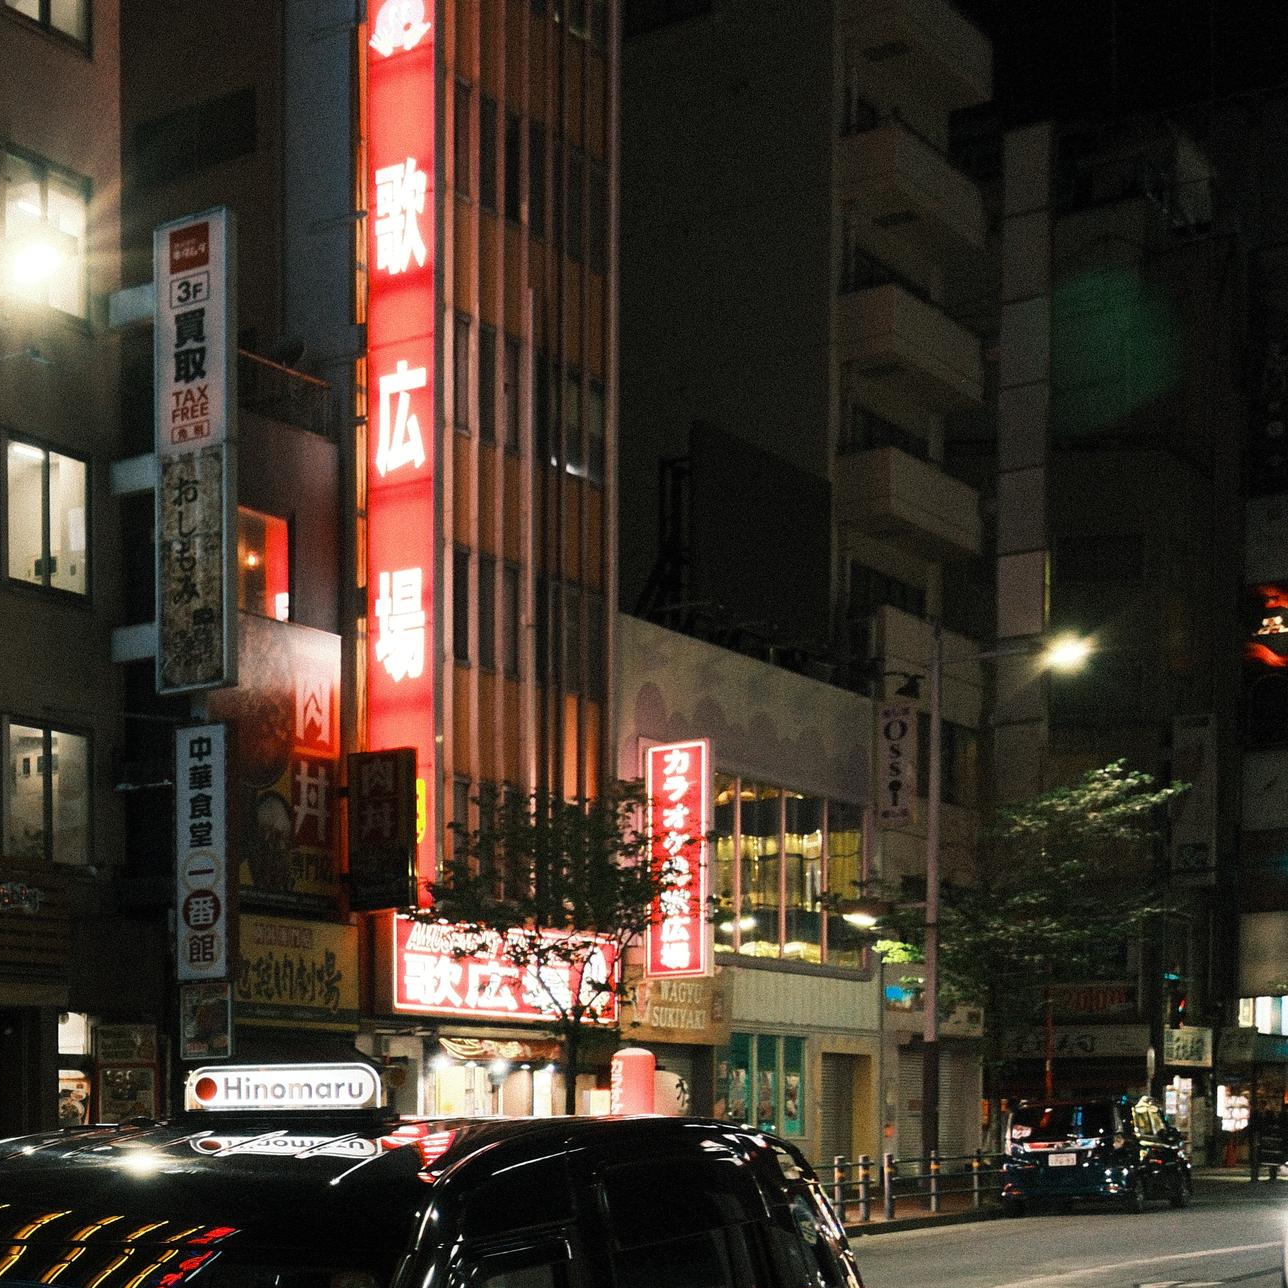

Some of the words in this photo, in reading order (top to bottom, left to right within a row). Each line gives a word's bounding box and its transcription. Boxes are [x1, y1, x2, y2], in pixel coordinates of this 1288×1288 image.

[177, 281, 204, 304] 3F
[174, 307, 206, 385] 買取
[172, 384, 209, 408] TAX
[172, 402, 209, 425] FREE
[374, 157, 428, 684] 歌広場
[293, 672, 332, 843] 肉丼
[187, 735, 215, 964] 中華食堂一番館
[404, 951, 574, 1020] 歌広場
[651, 1005, 707, 1030] SUKIYAKI
[223, 1077, 365, 1101] Hinomaru
